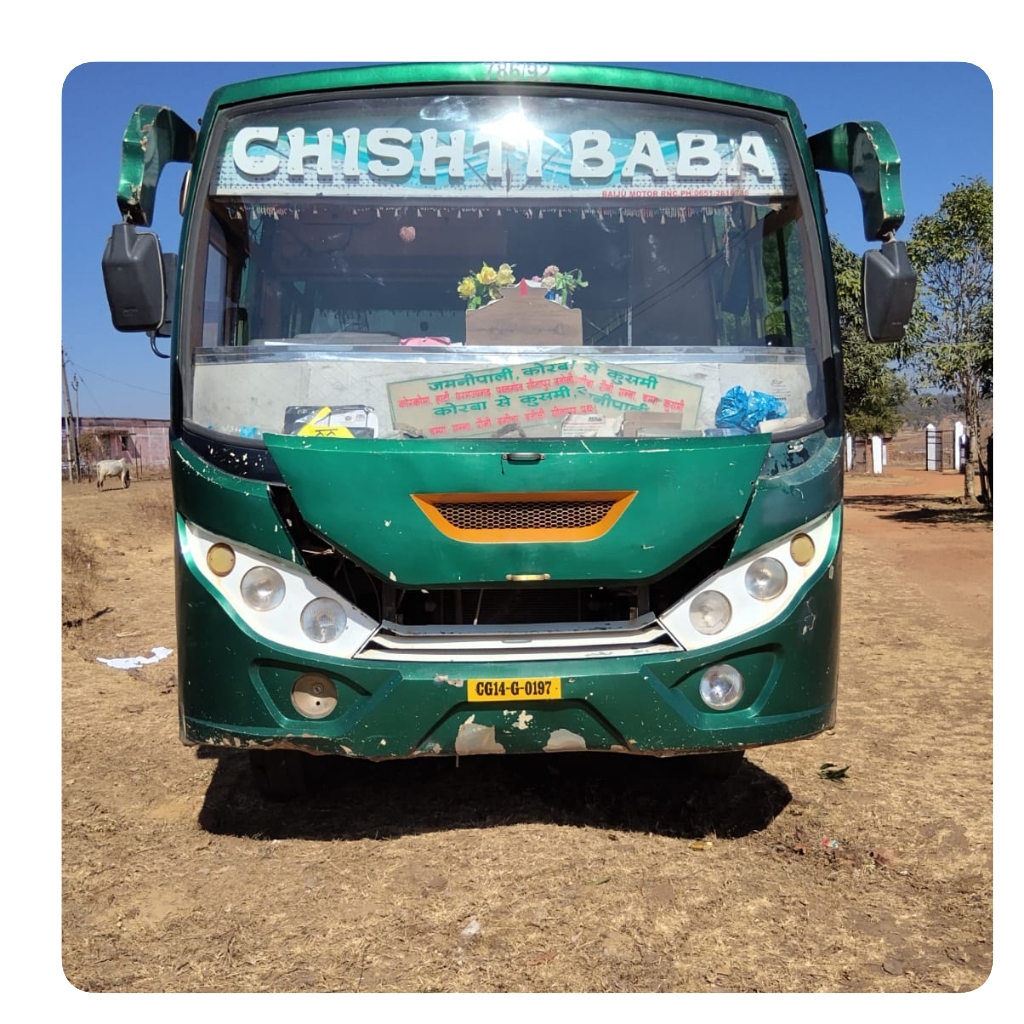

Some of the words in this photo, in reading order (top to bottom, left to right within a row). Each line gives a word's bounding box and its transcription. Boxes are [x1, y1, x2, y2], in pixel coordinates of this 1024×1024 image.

[232, 125, 543, 178] CHISHTI
[569, 129, 776, 179] BABA
[629, 190, 658, 198] MOTOR
[476, 681, 551, 696] CG14-G-0197
